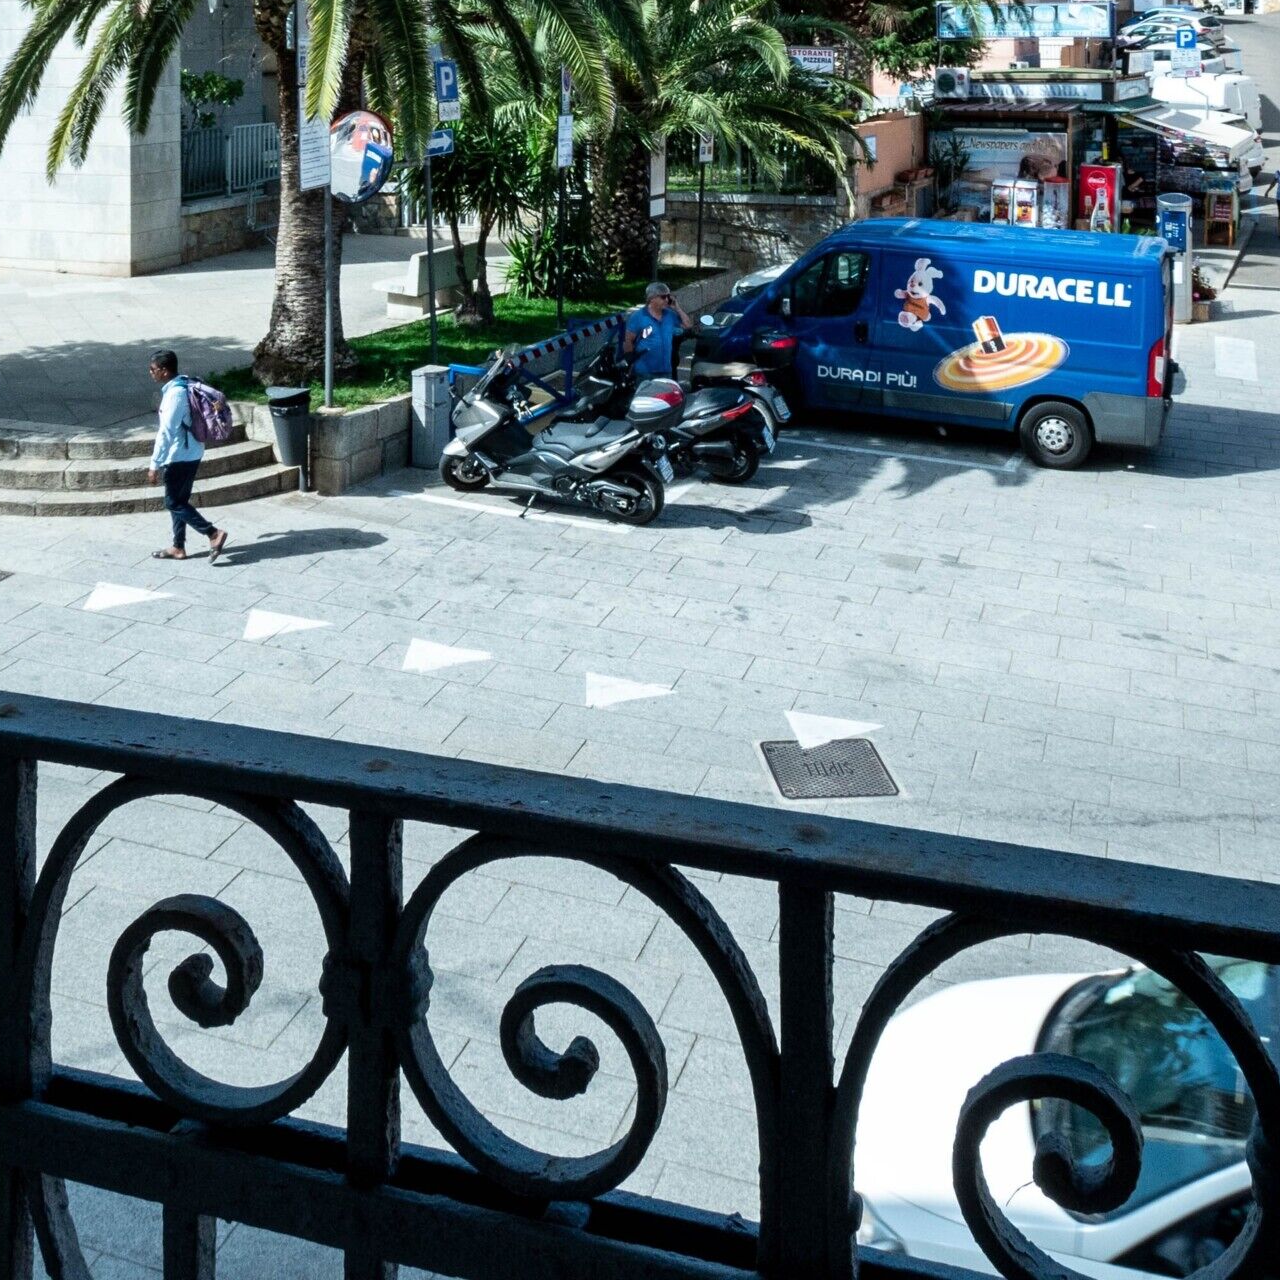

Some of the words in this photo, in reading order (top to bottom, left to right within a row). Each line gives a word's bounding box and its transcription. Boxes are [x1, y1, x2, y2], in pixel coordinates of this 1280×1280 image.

[1180, 31, 1193, 47] P
[440, 66, 453, 96] P
[973, 269, 1132, 308] DURACELL
[886, 370, 917, 388] PIÙ!
